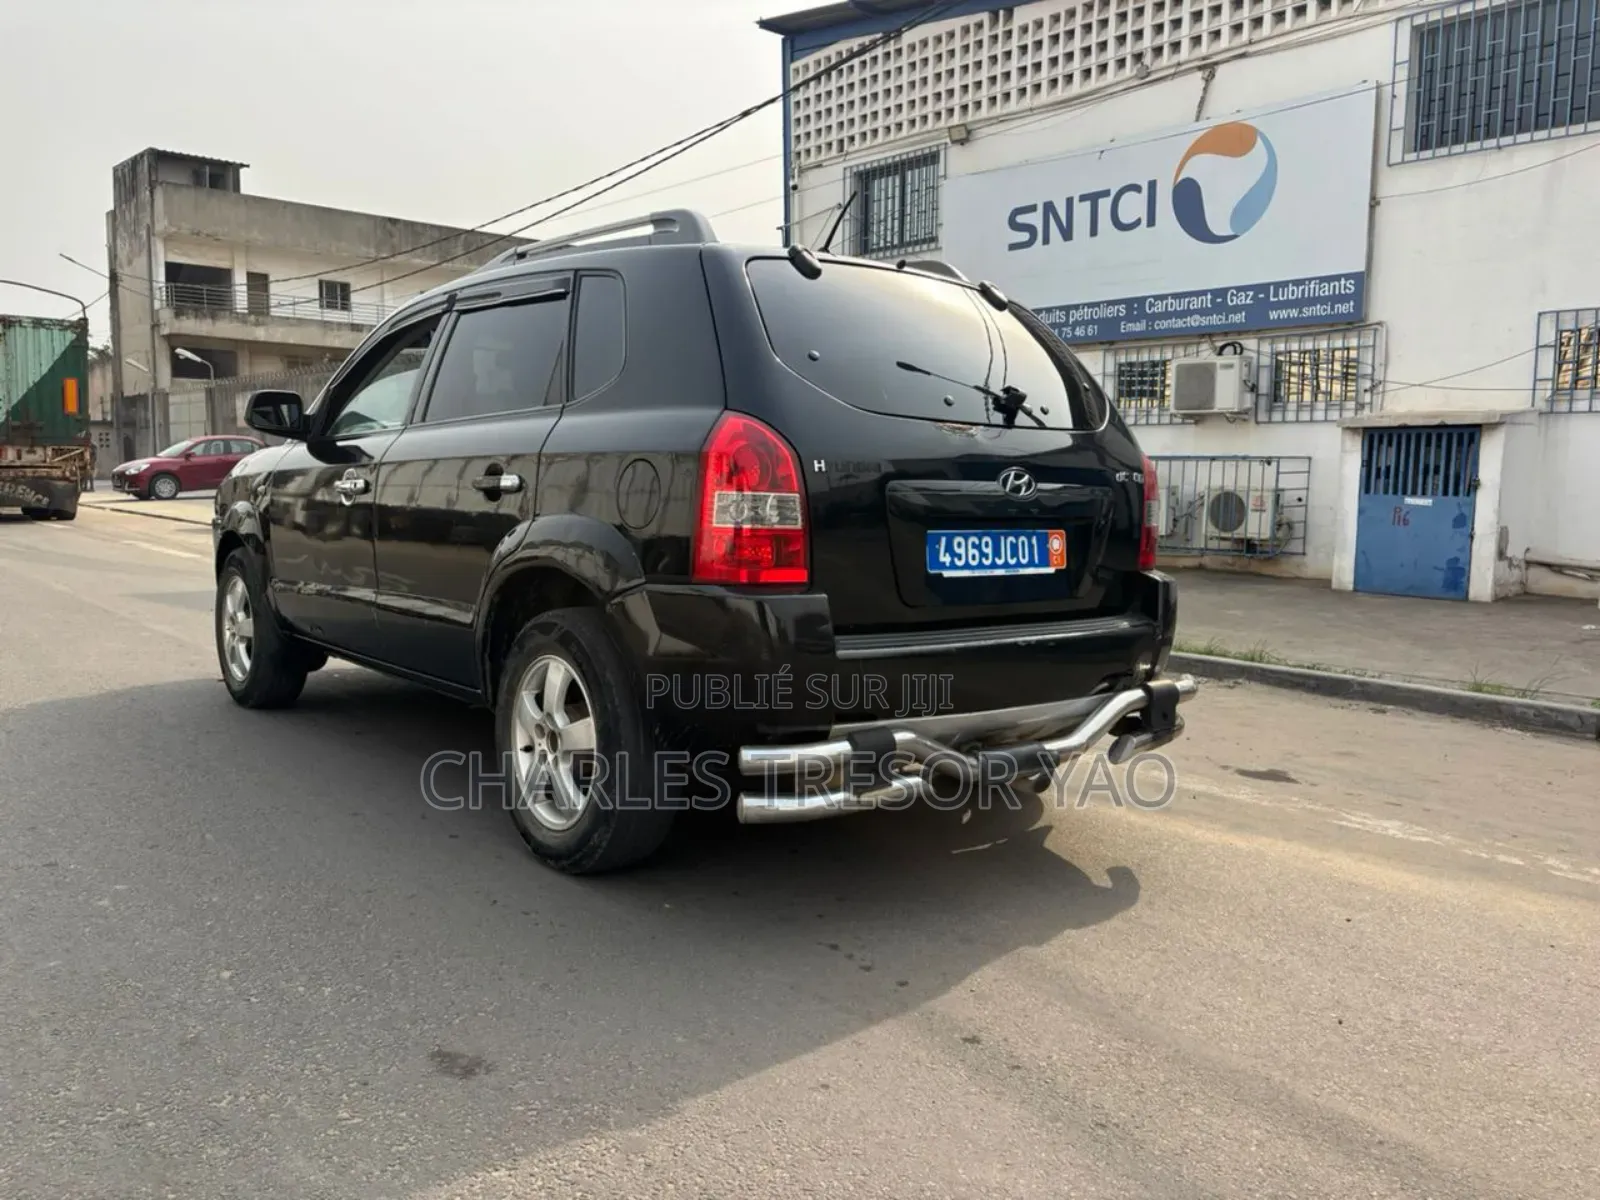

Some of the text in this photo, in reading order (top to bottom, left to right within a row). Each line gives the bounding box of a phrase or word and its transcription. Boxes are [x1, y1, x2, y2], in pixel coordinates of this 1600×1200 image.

[1007, 178, 1158, 252] SNTCI
[1069, 303, 1126, 325] pétroliers
[1145, 292, 1212, 314] Carburant
[1227, 289, 1254, 306] Gaz
[1269, 277, 1355, 302] Lubrifiants
[1269, 299, 1355, 320] www.sntci.net
[1061, 327, 1072, 338] 75
[1074, 326, 1085, 337] 46
[1087, 325, 1098, 336] 61
[1120, 319, 1146, 333] Email
[1154, 311, 1245, 330] contact@sntci.net
[938, 535, 1039, 567] 4969JC01
